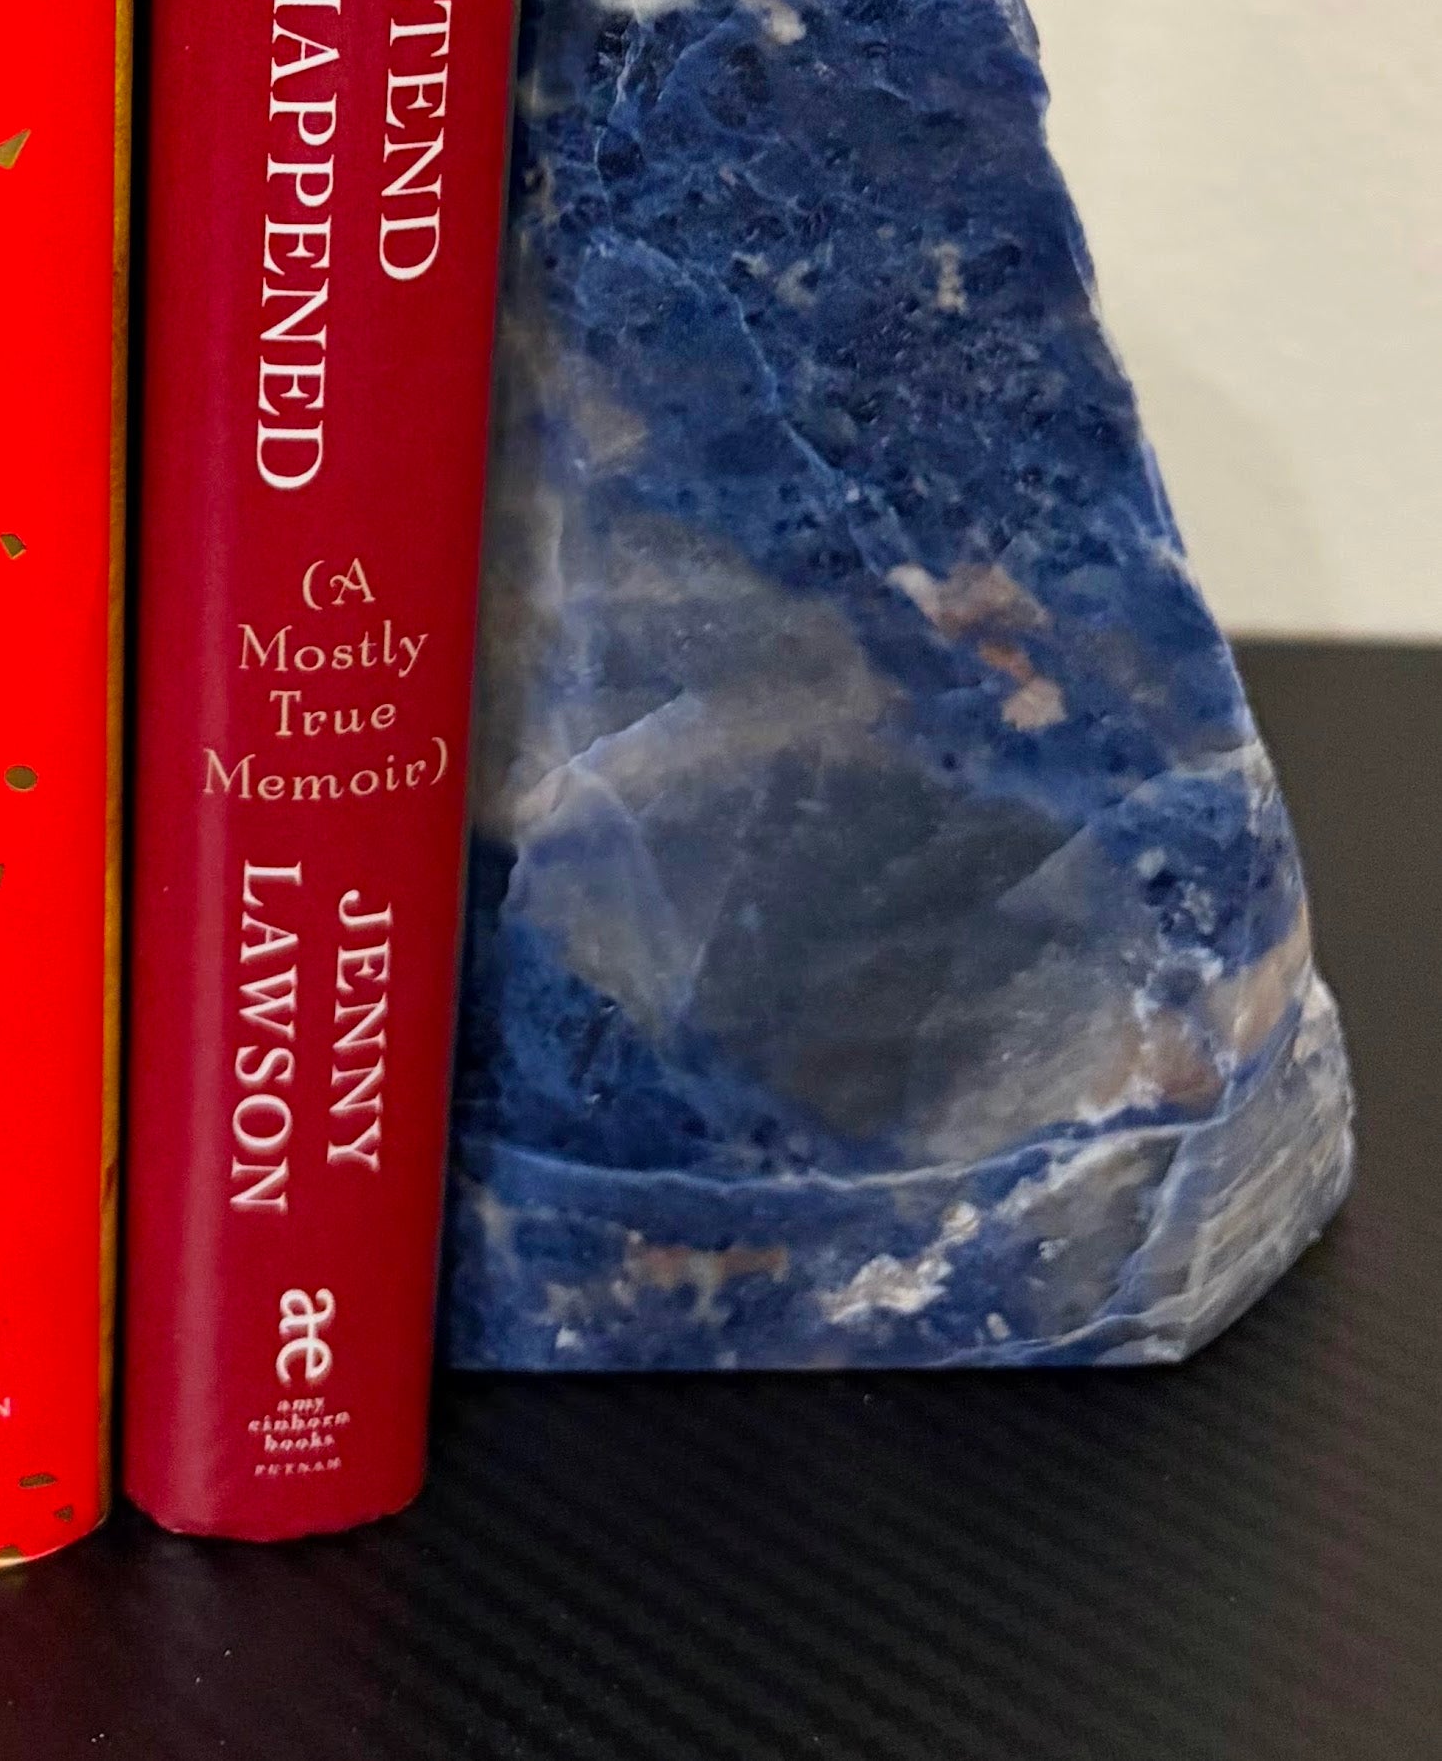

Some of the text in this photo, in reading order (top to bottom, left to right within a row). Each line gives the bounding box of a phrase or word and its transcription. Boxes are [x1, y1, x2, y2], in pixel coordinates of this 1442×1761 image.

[302, 557, 376, 611] (A
[238, 619, 429, 678] Mostly
[269, 689, 397, 737] True
[203, 736, 448, 801] Memoir)
[228, 859, 303, 1214] LAWSON
[325, 887, 394, 1171] JENNY
[264, 1431, 335, 1452] books
